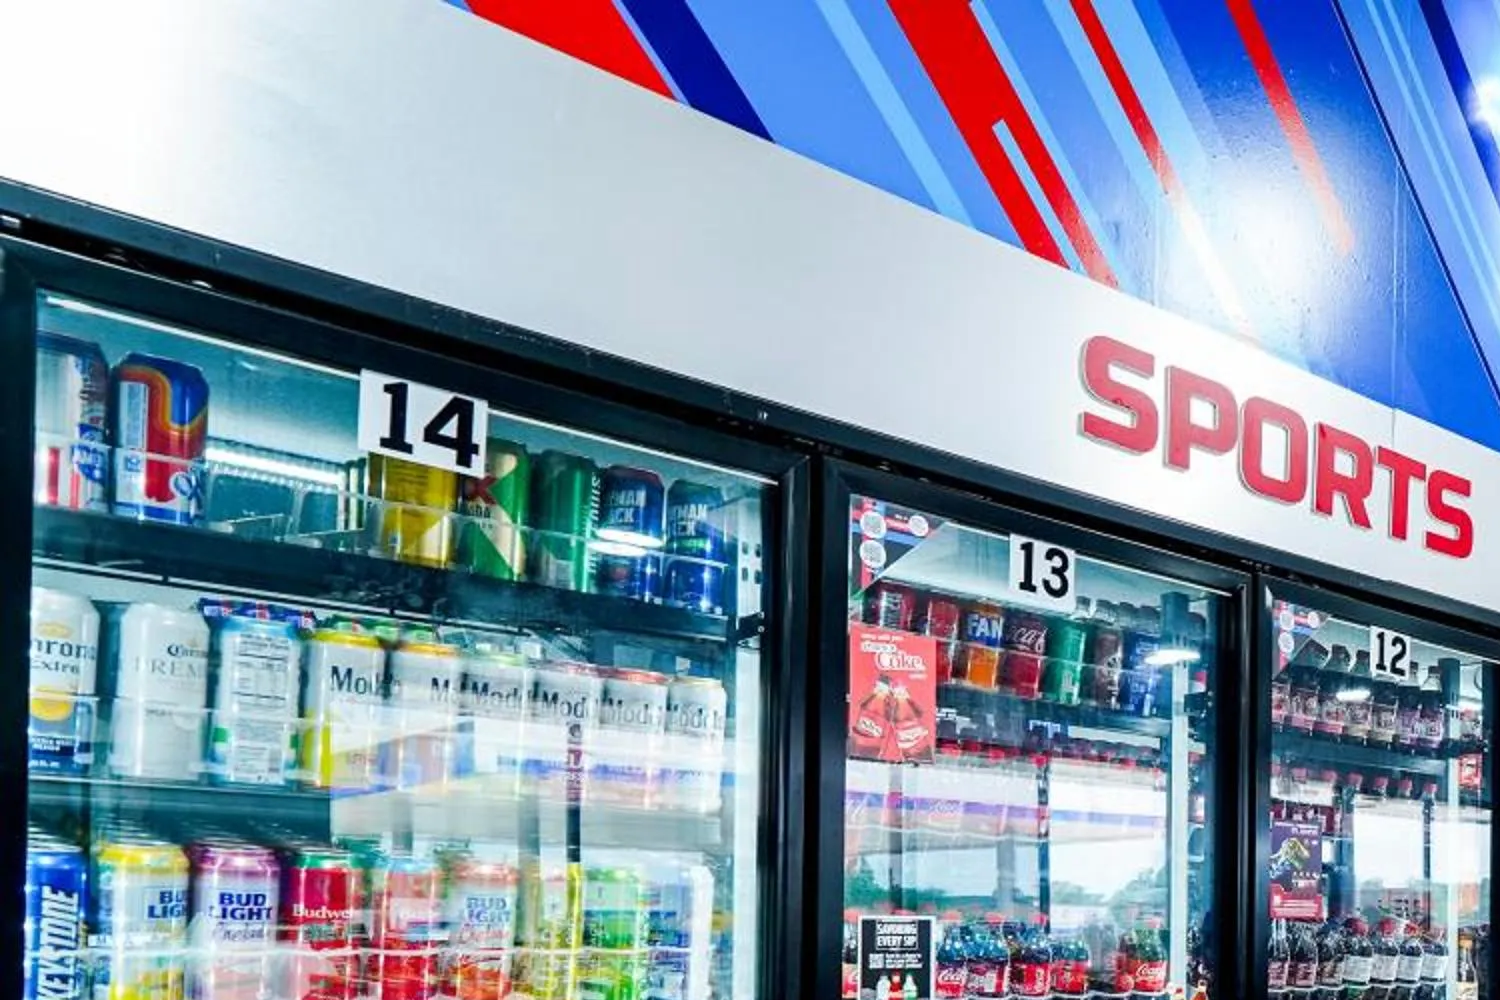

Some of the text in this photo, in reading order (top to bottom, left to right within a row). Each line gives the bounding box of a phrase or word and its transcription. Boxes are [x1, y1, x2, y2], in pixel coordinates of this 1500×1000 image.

[379, 381, 481, 468] 14
[1077, 335, 1474, 560] SPORTS
[1018, 541, 1070, 599] 13
[1375, 631, 1407, 677] 12
[208, 905, 273, 922] LIGHT
[219, 891, 267, 907] BUD
